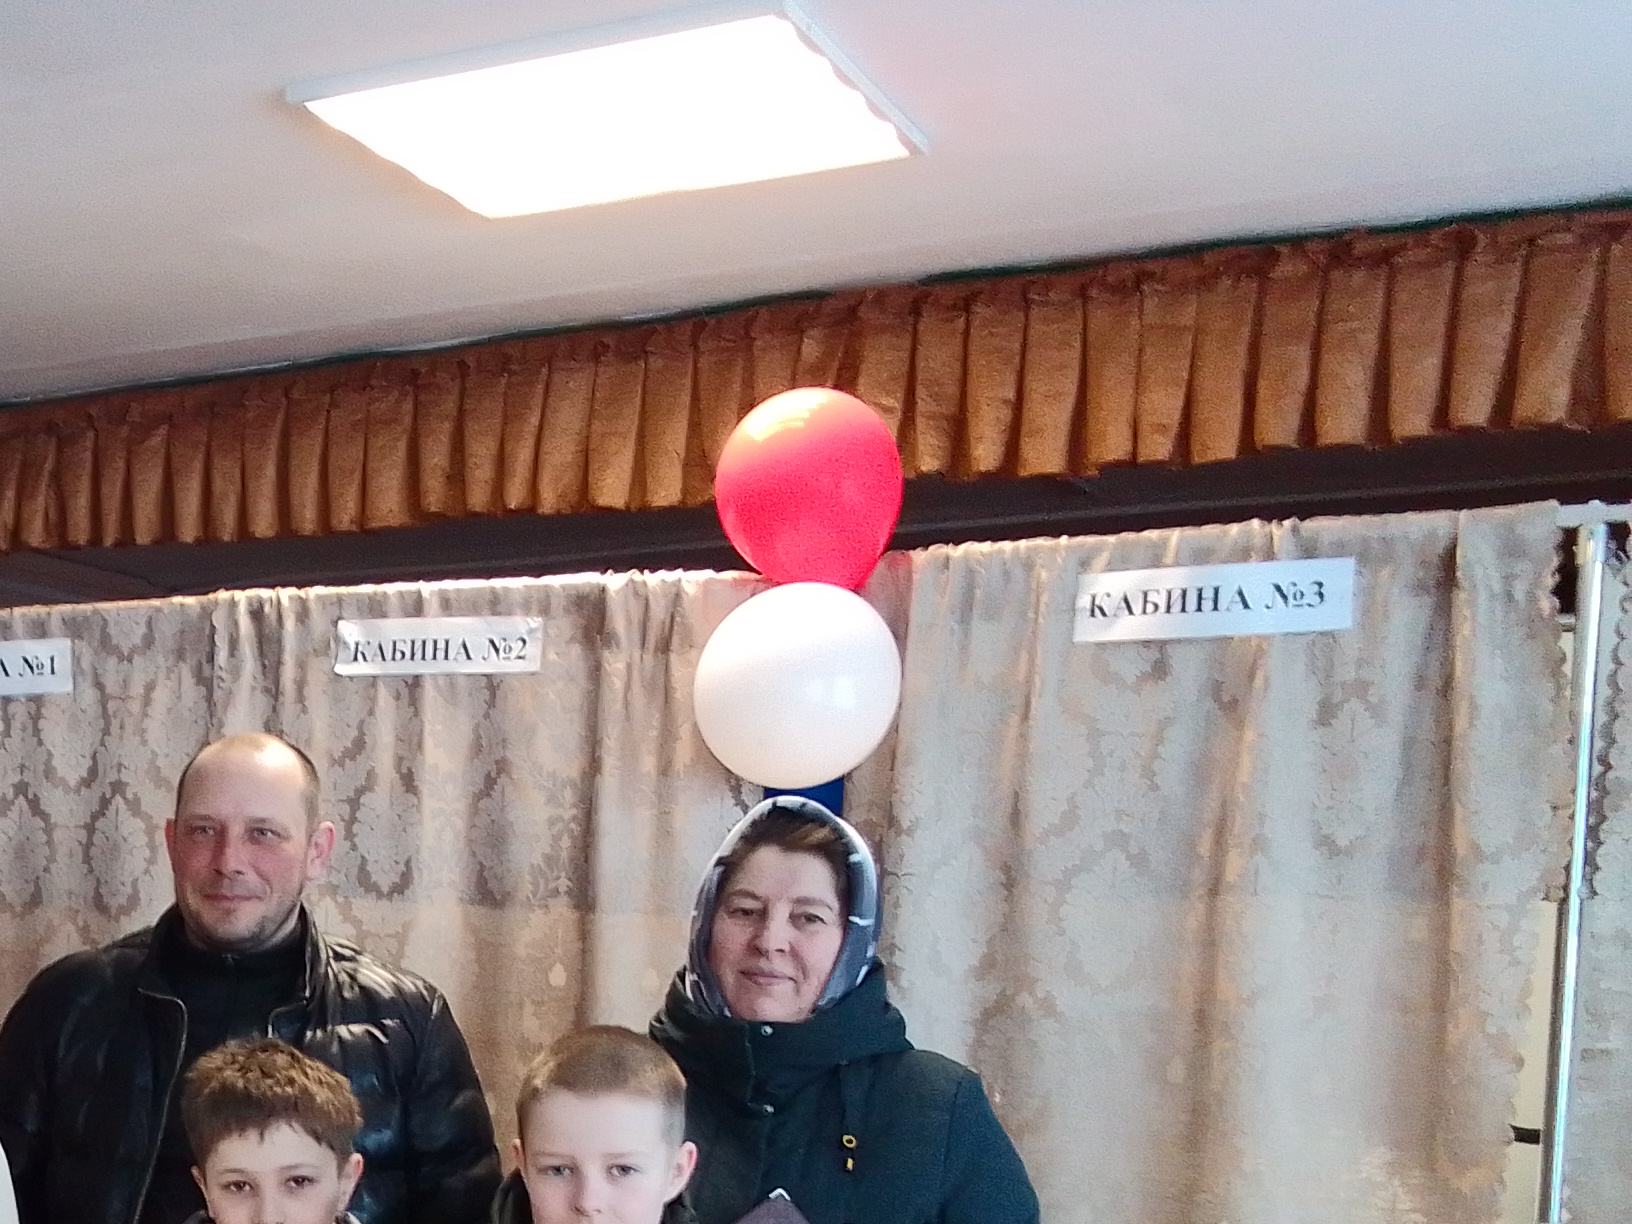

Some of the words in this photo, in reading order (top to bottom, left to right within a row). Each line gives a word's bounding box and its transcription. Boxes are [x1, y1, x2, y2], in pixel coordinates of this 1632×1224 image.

[1088, 583, 1253, 619] КАБИНА
[1264, 579, 1326, 610] №3
[352, 636, 472, 663] КАБИНА
[481, 635, 528, 661] №2
[18, 653, 57, 678] №1
